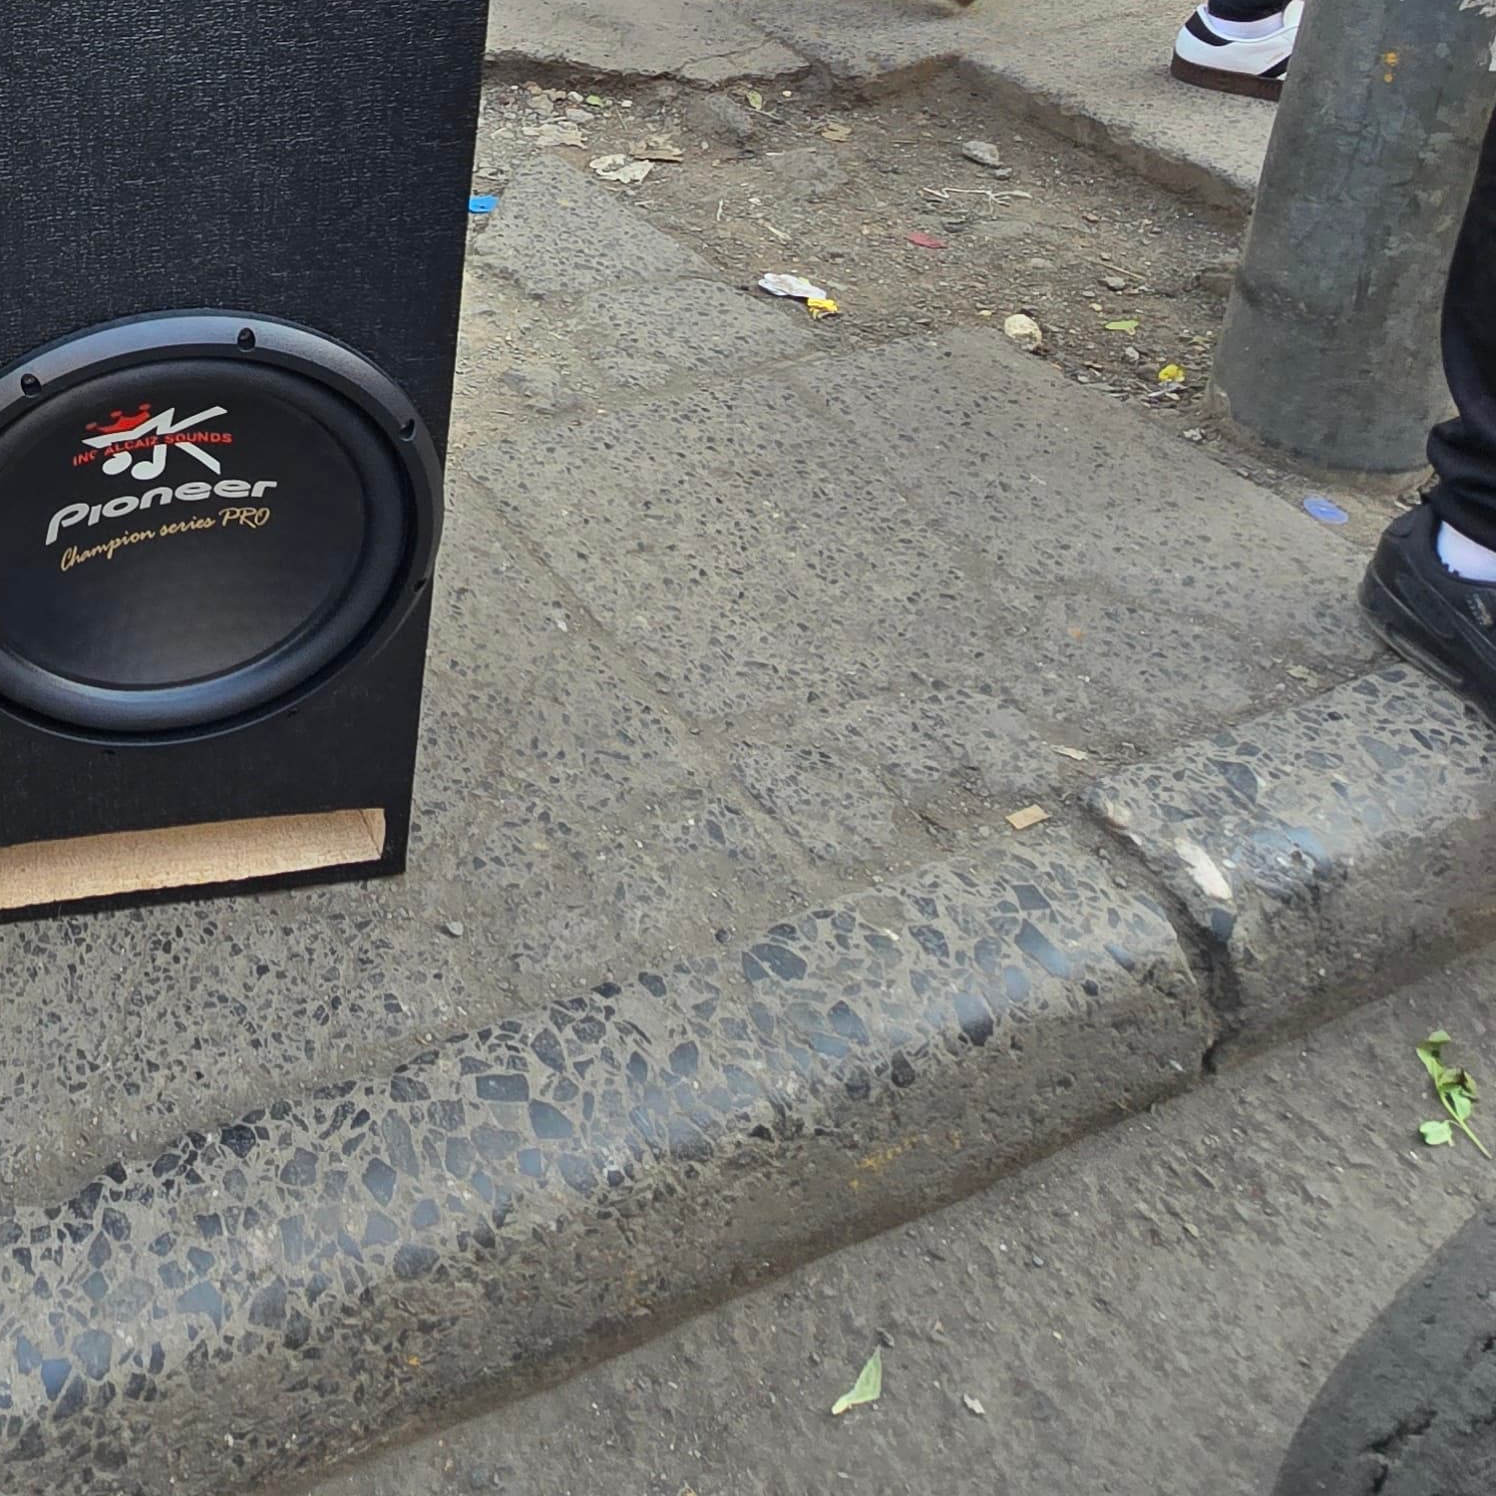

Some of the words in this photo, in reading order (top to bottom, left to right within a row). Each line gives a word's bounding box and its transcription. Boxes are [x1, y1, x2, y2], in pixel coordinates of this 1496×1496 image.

[164, 431, 233, 445] SOUNDS
[44, 478, 278, 546] Pioneer
[60, 529, 156, 572] Champion
[159, 517, 216, 537] series
[218, 506, 271, 529] PRO
